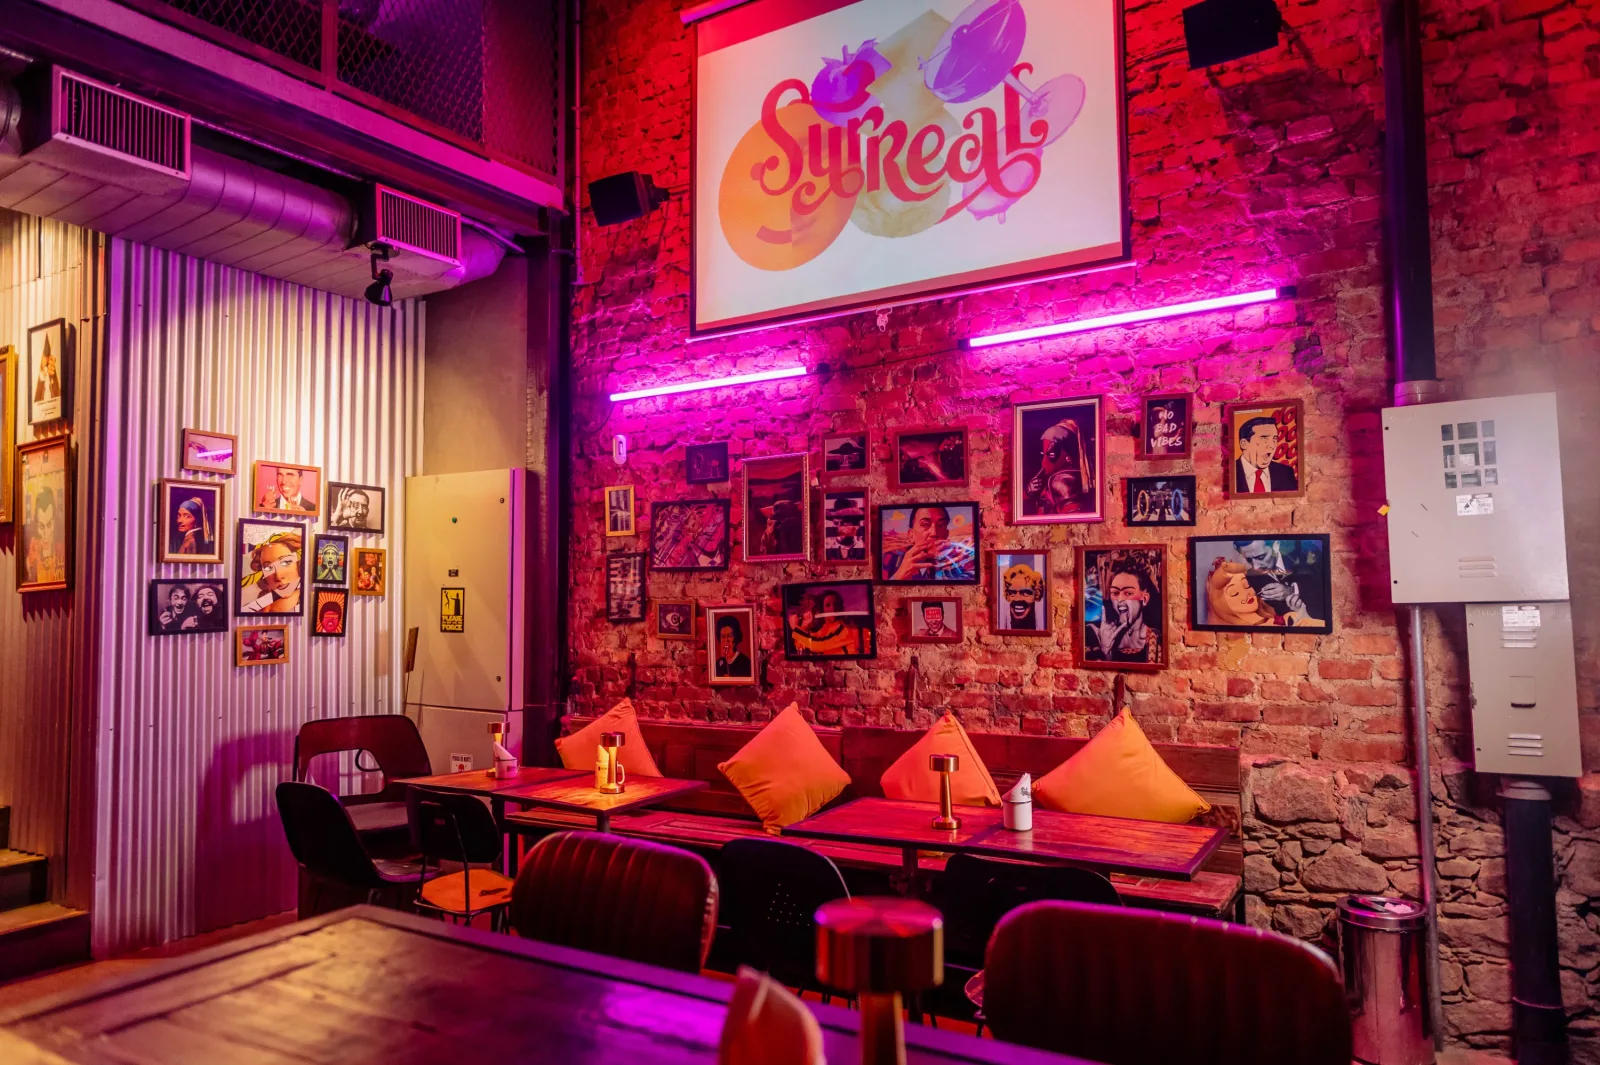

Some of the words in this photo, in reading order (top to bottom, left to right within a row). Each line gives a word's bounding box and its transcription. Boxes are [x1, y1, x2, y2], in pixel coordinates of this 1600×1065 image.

[1158, 409, 1175, 420] NO
[1155, 422, 1177, 433] BAD
[1150, 436, 1183, 448] VIBES
